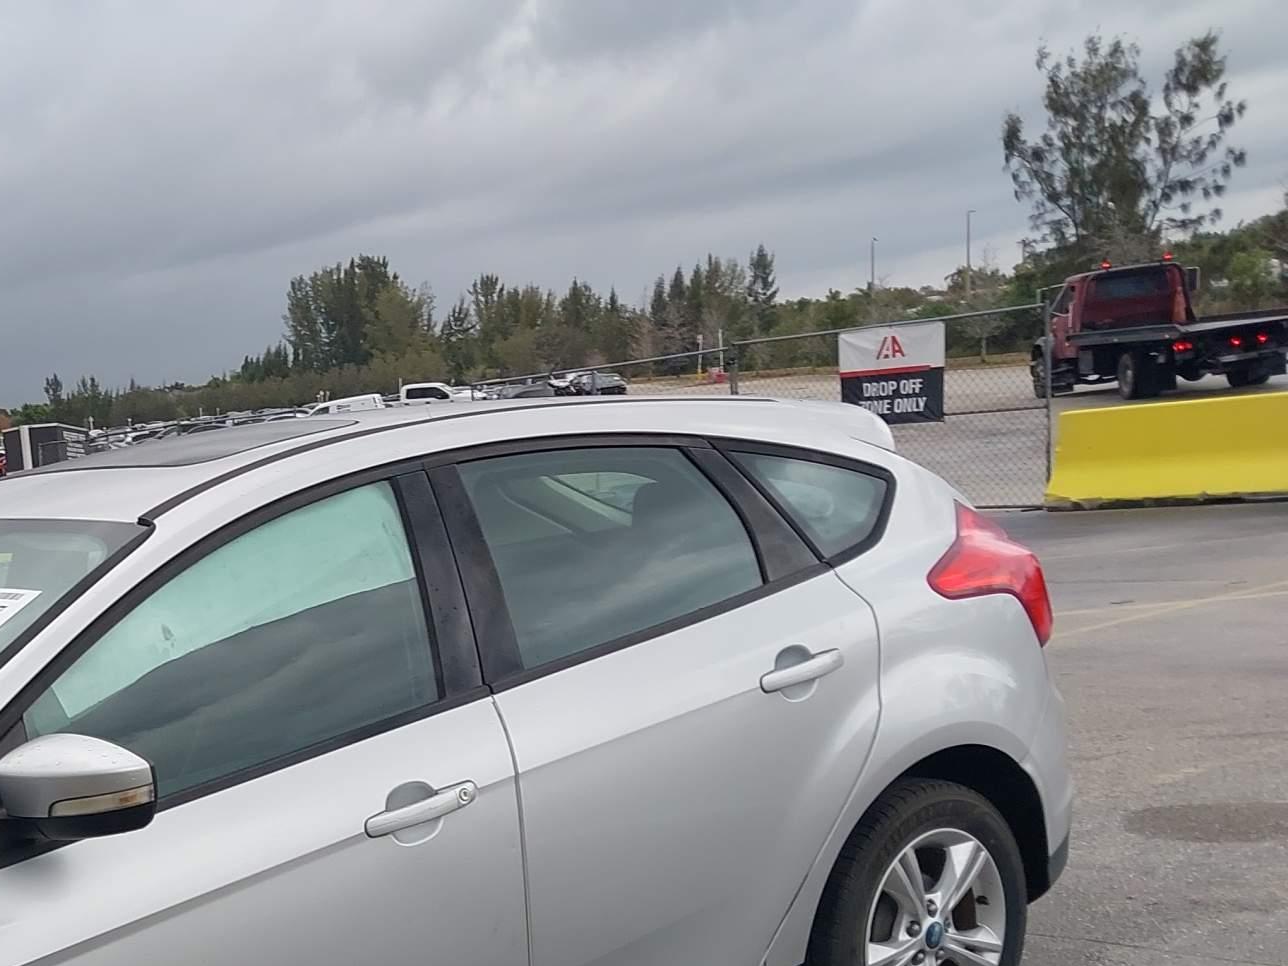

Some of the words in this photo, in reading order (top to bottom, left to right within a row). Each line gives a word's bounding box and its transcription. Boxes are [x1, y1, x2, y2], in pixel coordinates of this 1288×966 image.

[862, 381, 897, 397] DROP
[899, 378, 923, 394] OFF
[893, 397, 927, 413] ONLY
